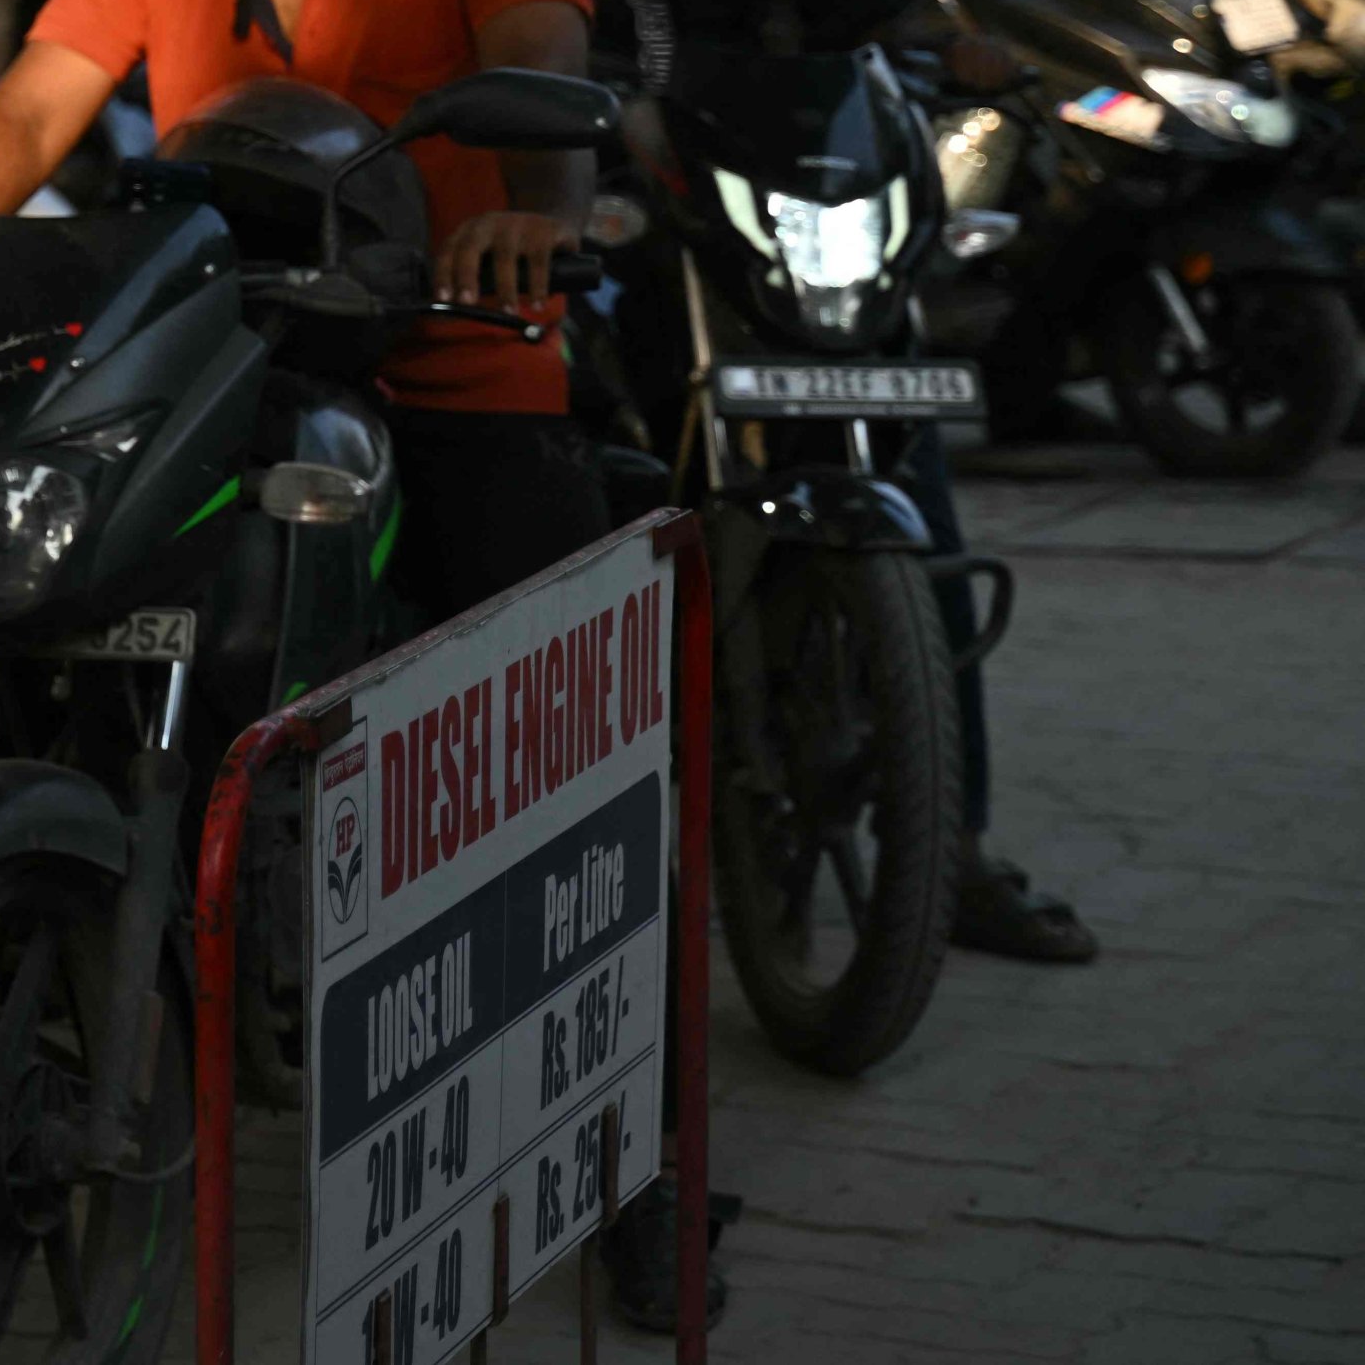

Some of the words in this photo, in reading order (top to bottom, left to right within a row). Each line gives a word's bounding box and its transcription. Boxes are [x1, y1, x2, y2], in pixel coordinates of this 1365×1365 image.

[380, 676, 497, 901] DIESEL
[504, 606, 614, 822] ENGINE
[619, 579, 664, 746] OIL
[335, 812, 356, 858] HP
[544, 871, 580, 972] Per
[580, 842, 626, 947] Litre
[366, 955, 438, 1103] LOOSE
[441, 932, 473, 1049] OIL
[540, 1010, 570, 1111] Rs.
[534, 1155, 565, 1255] Rs.
[571, 1088, 632, 1225] 25/-
